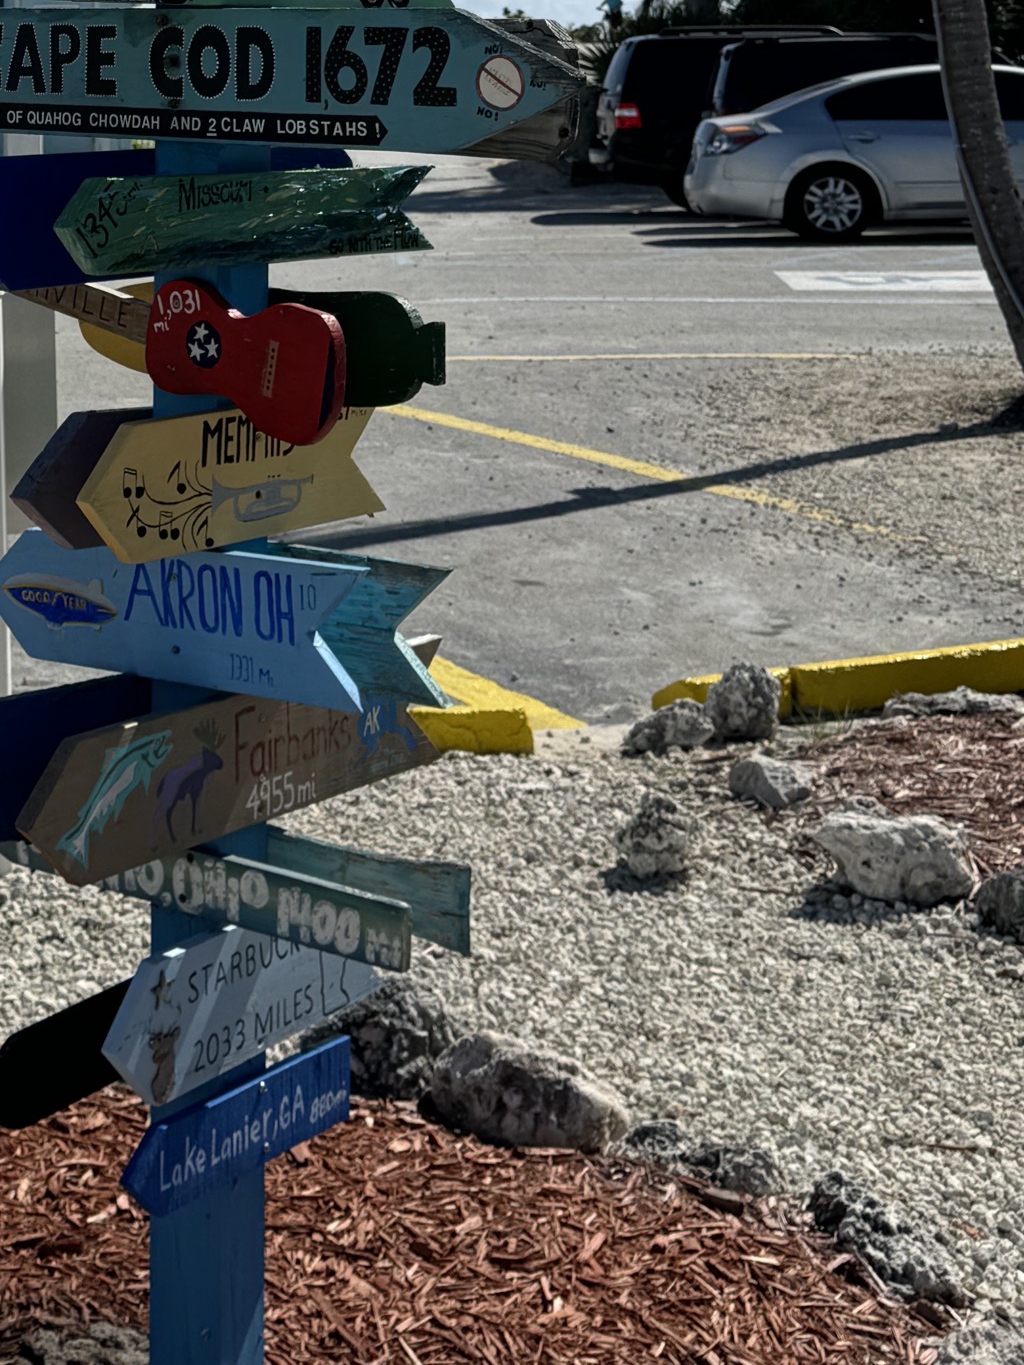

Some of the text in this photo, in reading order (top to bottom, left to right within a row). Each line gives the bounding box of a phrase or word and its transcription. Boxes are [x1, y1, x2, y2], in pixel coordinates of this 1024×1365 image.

[148, 25, 275, 102] COD
[6, 110, 24, 124] OF
[26, 110, 82, 127] QUAHOG
[88, 112, 161, 130] CHOWDAH
[169, 116, 202, 132] AND
[206, 117, 218, 136] 2
[220, 117, 266, 134] CLAW
[36, 285, 132, 328] VILLE
[153, 317, 170, 334] mi
[157, 288, 201, 321] 1,031
[124, 558, 243, 637] AKRON
[235, 701, 382, 785] Fairbanks AK
[245, 771, 317, 820] 4955 mi
[194, 984, 314, 1073] 2033 MILES
[160, 1135, 207, 1192] Lake
